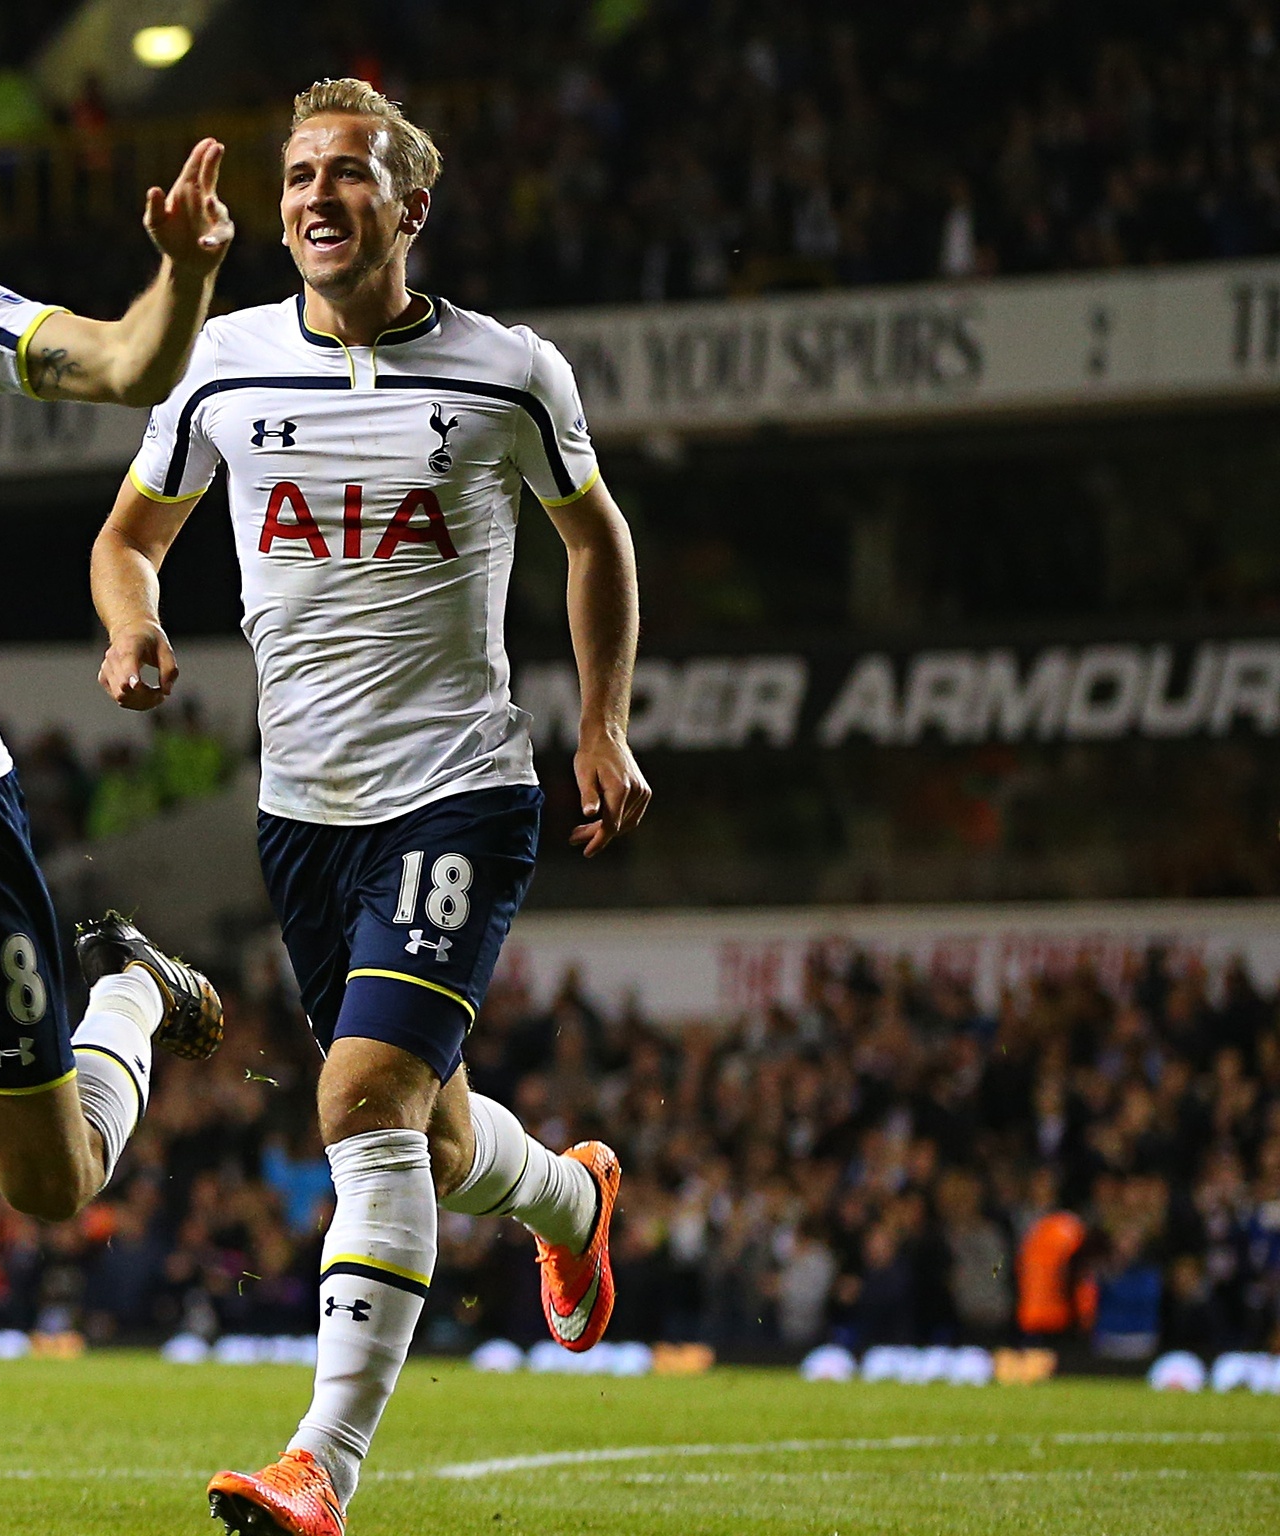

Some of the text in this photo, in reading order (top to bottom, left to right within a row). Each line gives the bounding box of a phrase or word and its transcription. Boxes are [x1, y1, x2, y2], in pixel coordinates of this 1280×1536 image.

[642, 322, 769, 400] YOU
[782, 306, 986, 394] SPURS
[257, 480, 460, 560] AIA
[818, 641, 1280, 748] ARMOUR
[392, 850, 475, 931] 18
